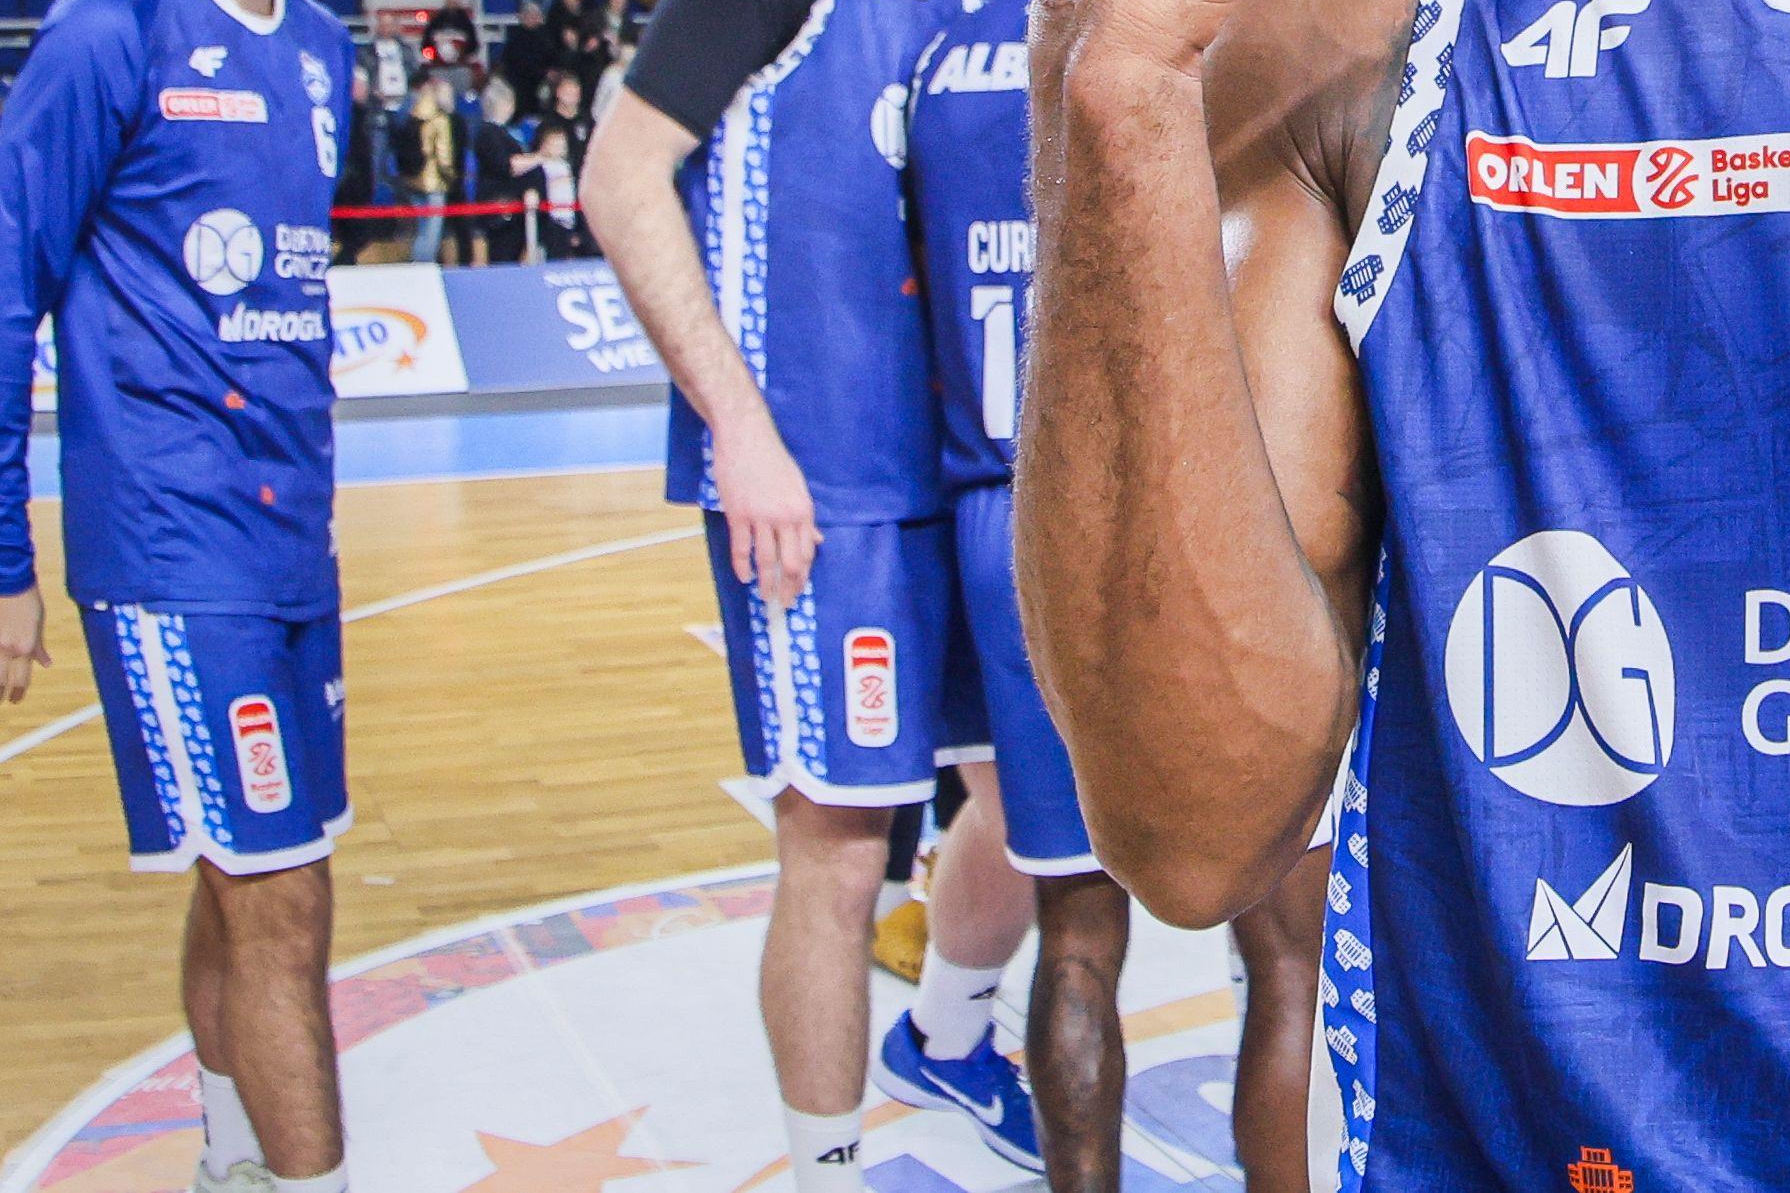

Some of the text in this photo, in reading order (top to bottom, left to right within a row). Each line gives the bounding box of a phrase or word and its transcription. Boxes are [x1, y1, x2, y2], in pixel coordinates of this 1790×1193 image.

[927, 42, 1029, 95] ALB
[1477, 152, 1619, 200] ORLEN
[1711, 178, 1770, 206] Liga
[967, 220, 1034, 274] CUR
[556, 287, 638, 351] SE
[585, 341, 660, 374] WIE
